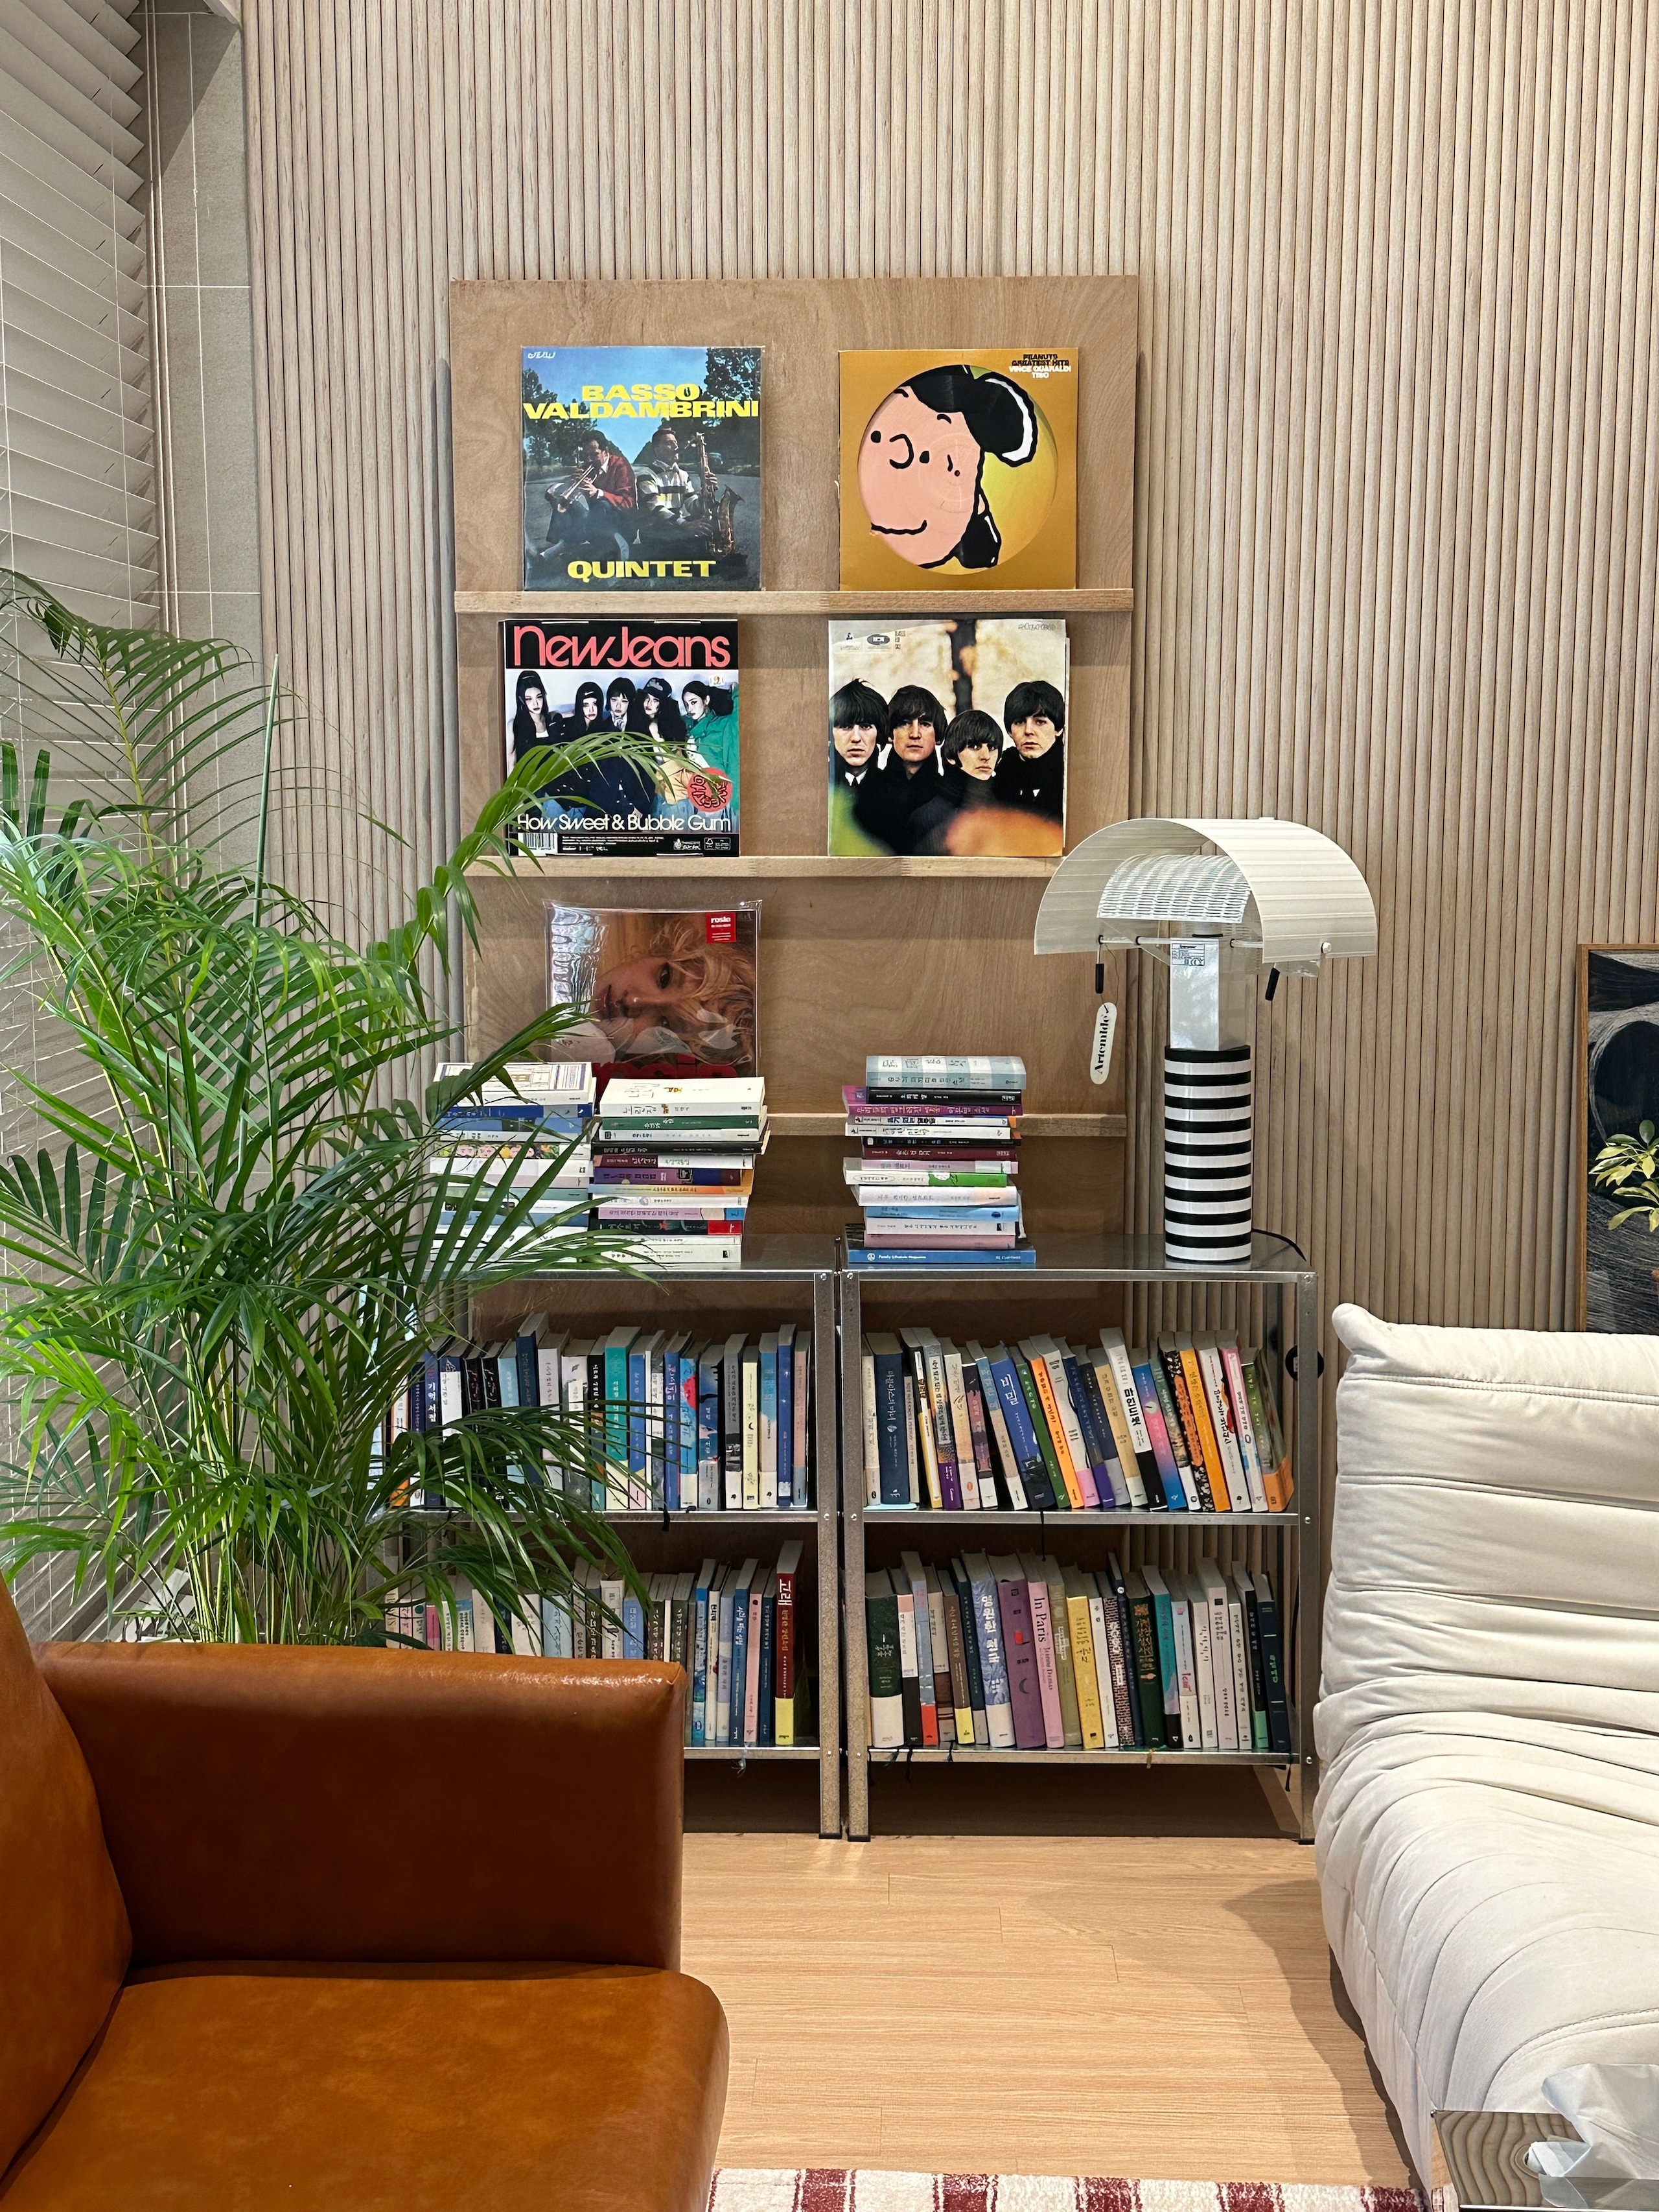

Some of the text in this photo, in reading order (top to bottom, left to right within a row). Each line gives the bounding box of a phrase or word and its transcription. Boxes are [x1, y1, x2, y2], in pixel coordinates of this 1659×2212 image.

[582, 383, 700, 402] BASSO
[523, 401, 759, 419] VALDAMBRINI
[567, 560, 717, 583] QUINTET
[517, 813, 731, 832] How Sweet & Bubble Gum
[1095, 1014, 1110, 1074] Artemide
[778, 1578, 793, 1606] 고래
[1034, 1598, 1047, 1642] In Paris
